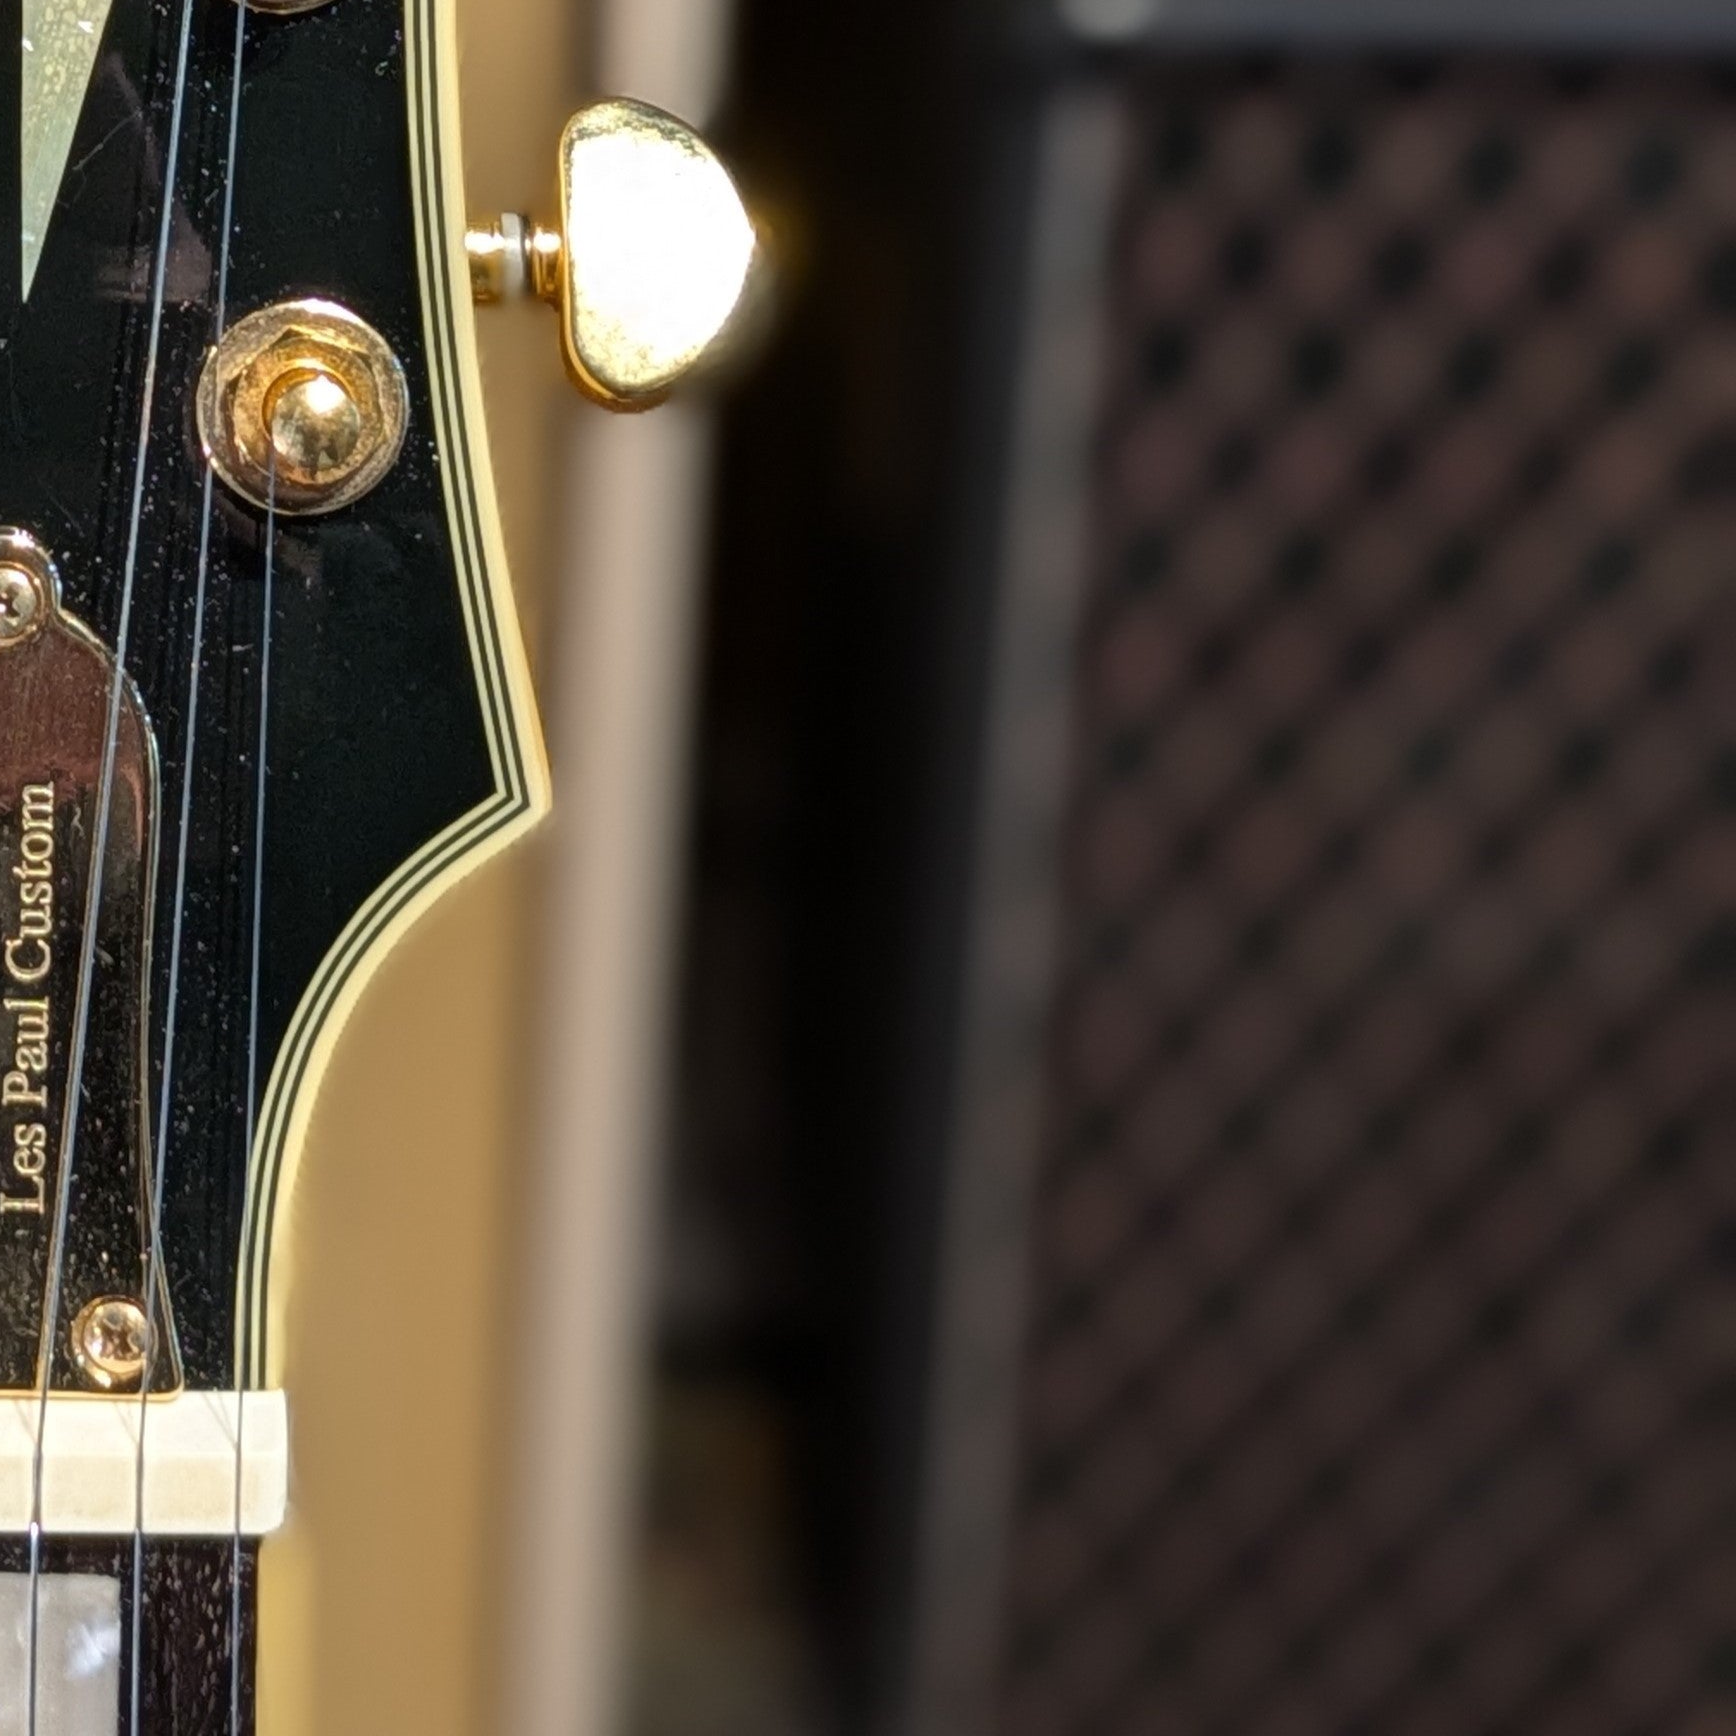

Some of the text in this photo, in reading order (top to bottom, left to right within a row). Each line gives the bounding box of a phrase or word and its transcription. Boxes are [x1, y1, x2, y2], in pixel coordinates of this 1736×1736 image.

[0, 781, 55, 1215] Les Paul Custom
